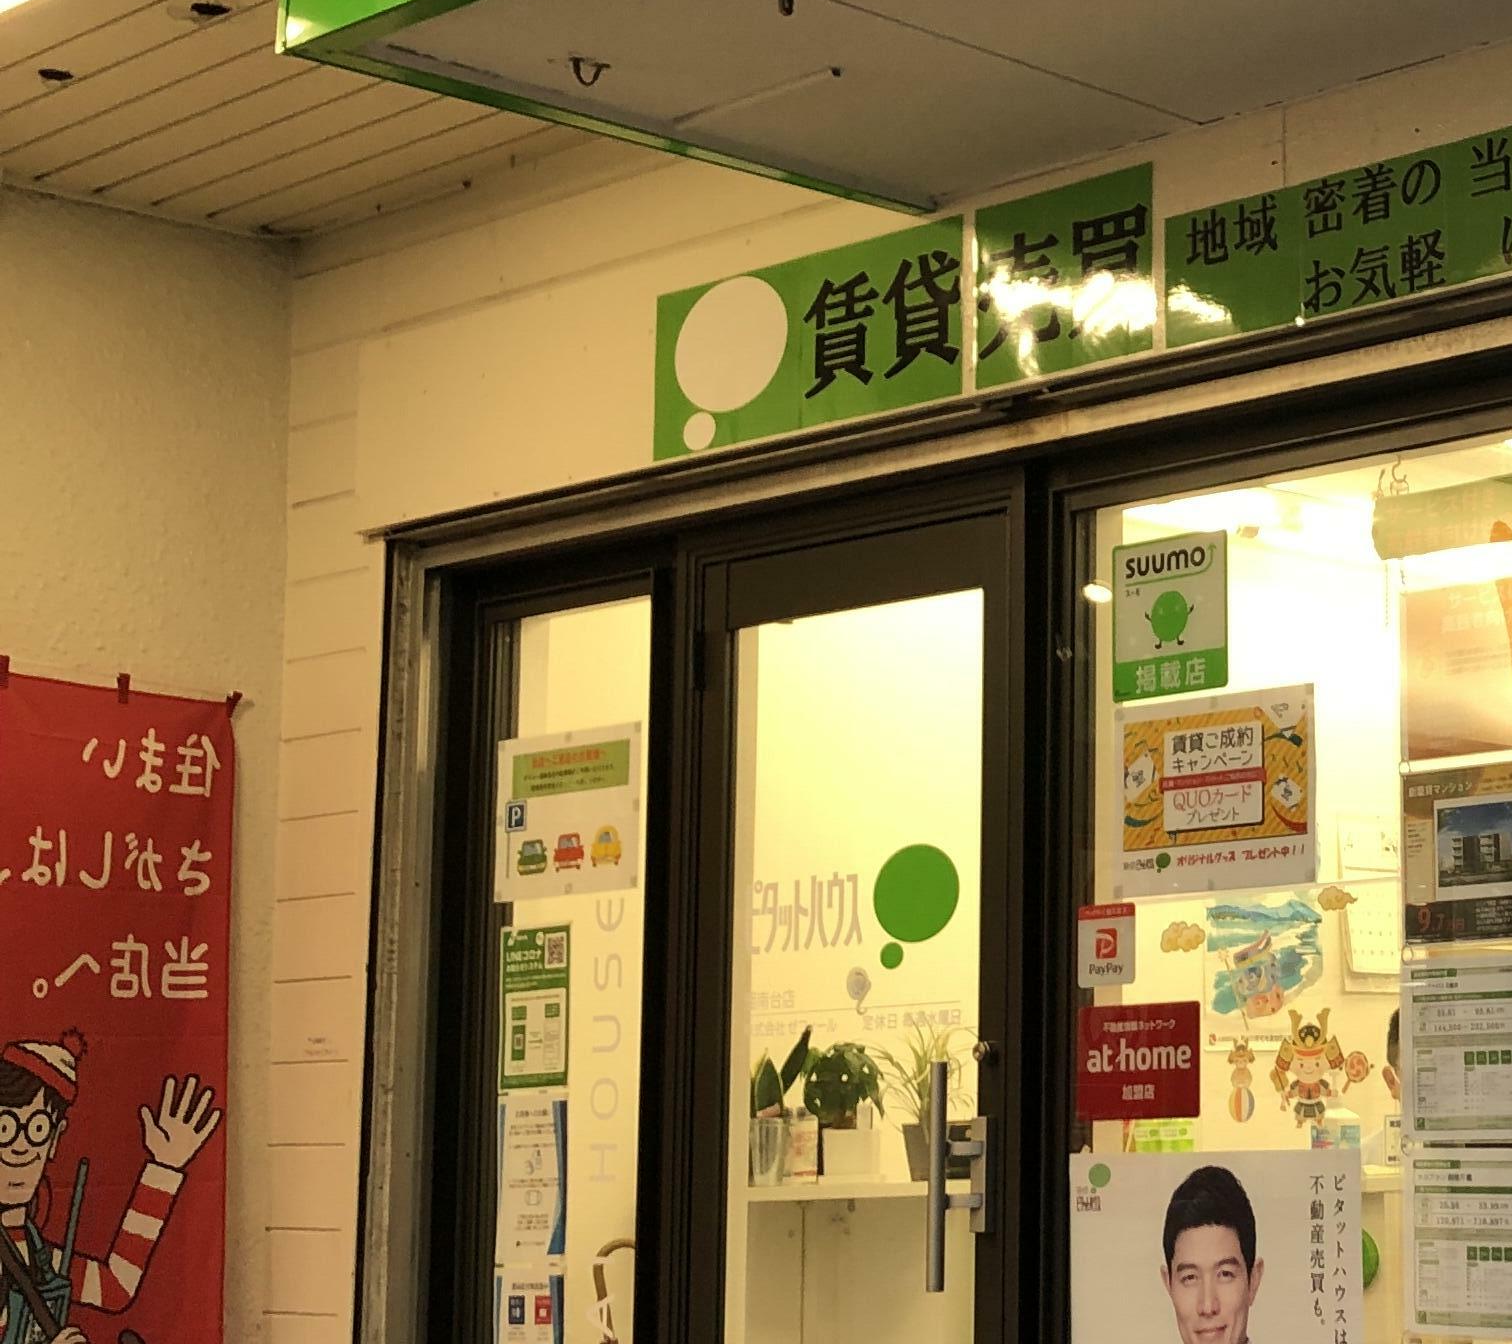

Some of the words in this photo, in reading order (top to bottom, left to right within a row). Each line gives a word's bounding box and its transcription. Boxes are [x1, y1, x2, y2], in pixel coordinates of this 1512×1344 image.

[1185, 193, 1279, 266] 地域
[1302, 158, 1443, 239] 密着の
[1302, 227, 1446, 313] お気軽
[1135, 656, 1206, 694] 掲載店
[1172, 752, 1254, 774] キャンペーン
[1088, 962, 1124, 976] PayPay
[1086, 1049, 1113, 1073] at
[1115, 1038, 1192, 1072] home
[1309, 1175, 1327, 1325] 不動産売買も。
